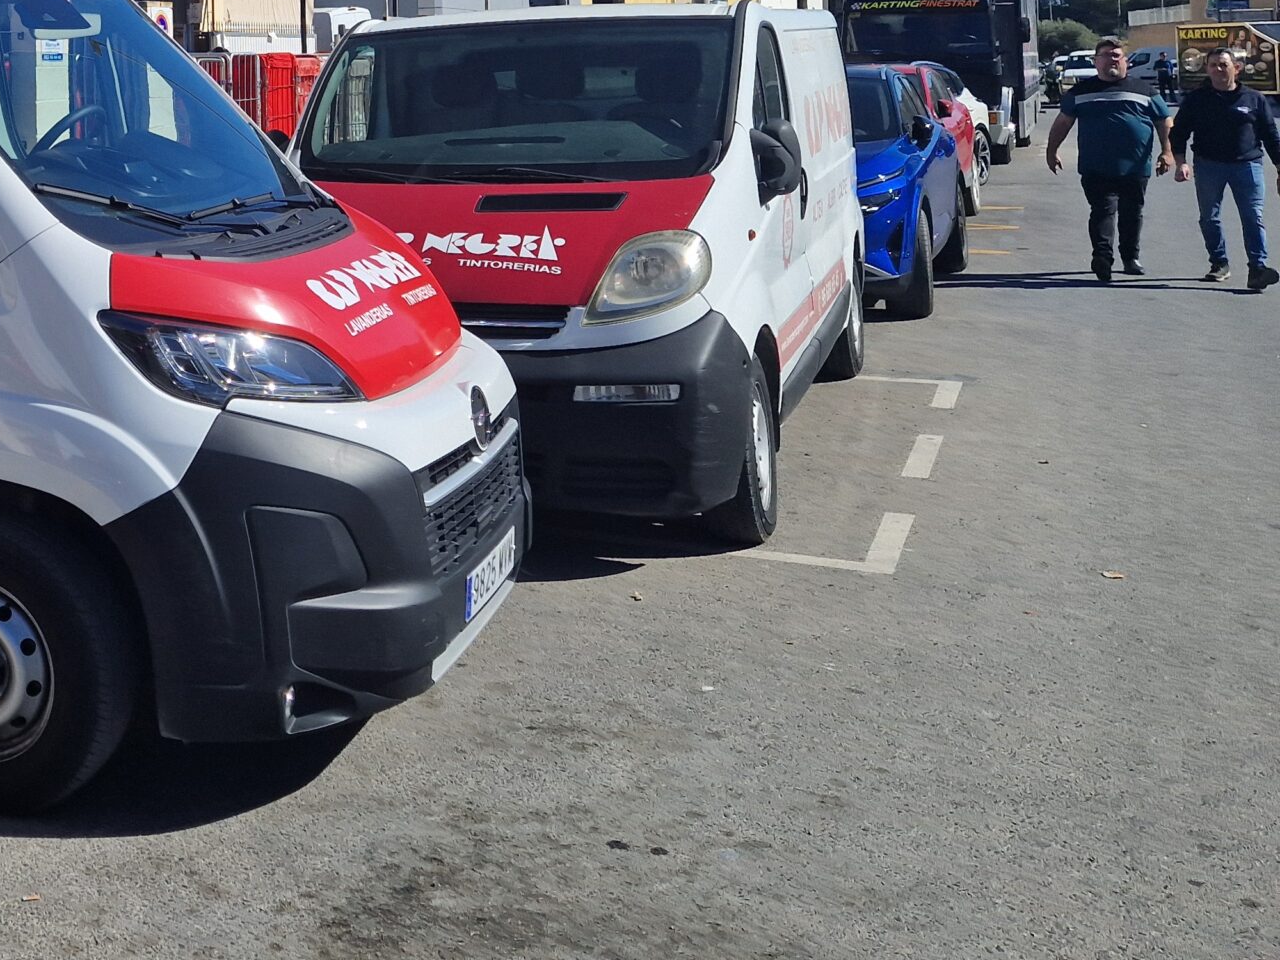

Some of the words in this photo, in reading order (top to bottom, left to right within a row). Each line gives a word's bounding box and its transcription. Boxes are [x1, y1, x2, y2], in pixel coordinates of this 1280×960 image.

[1179, 28, 1227, 39] KARTING
[457, 258, 562, 275] TINTORERIAS
[401, 283, 437, 307] TINTORERIAS
[344, 303, 393, 337] LAVANDERIAS
[473, 556, 497, 604] 9825
